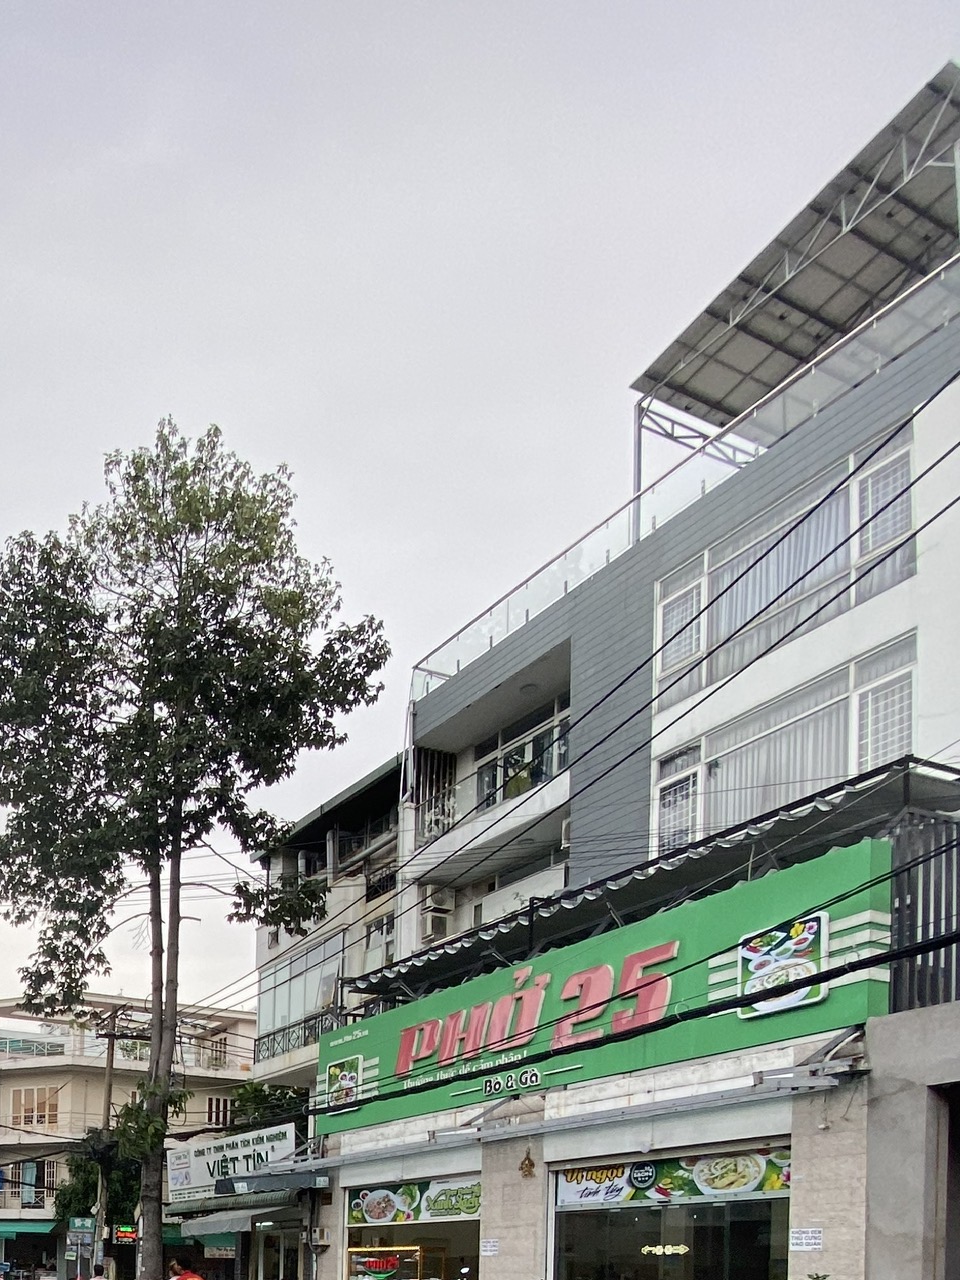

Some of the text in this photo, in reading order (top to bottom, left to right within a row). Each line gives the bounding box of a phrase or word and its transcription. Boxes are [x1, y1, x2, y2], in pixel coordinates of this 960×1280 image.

[394, 941, 681, 1079] PHỞ 25
[483, 1069, 541, 1096] Bò & Gà
[206, 1153, 240, 1178] VIỆT
[242, 1149, 269, 1171] TÍN
